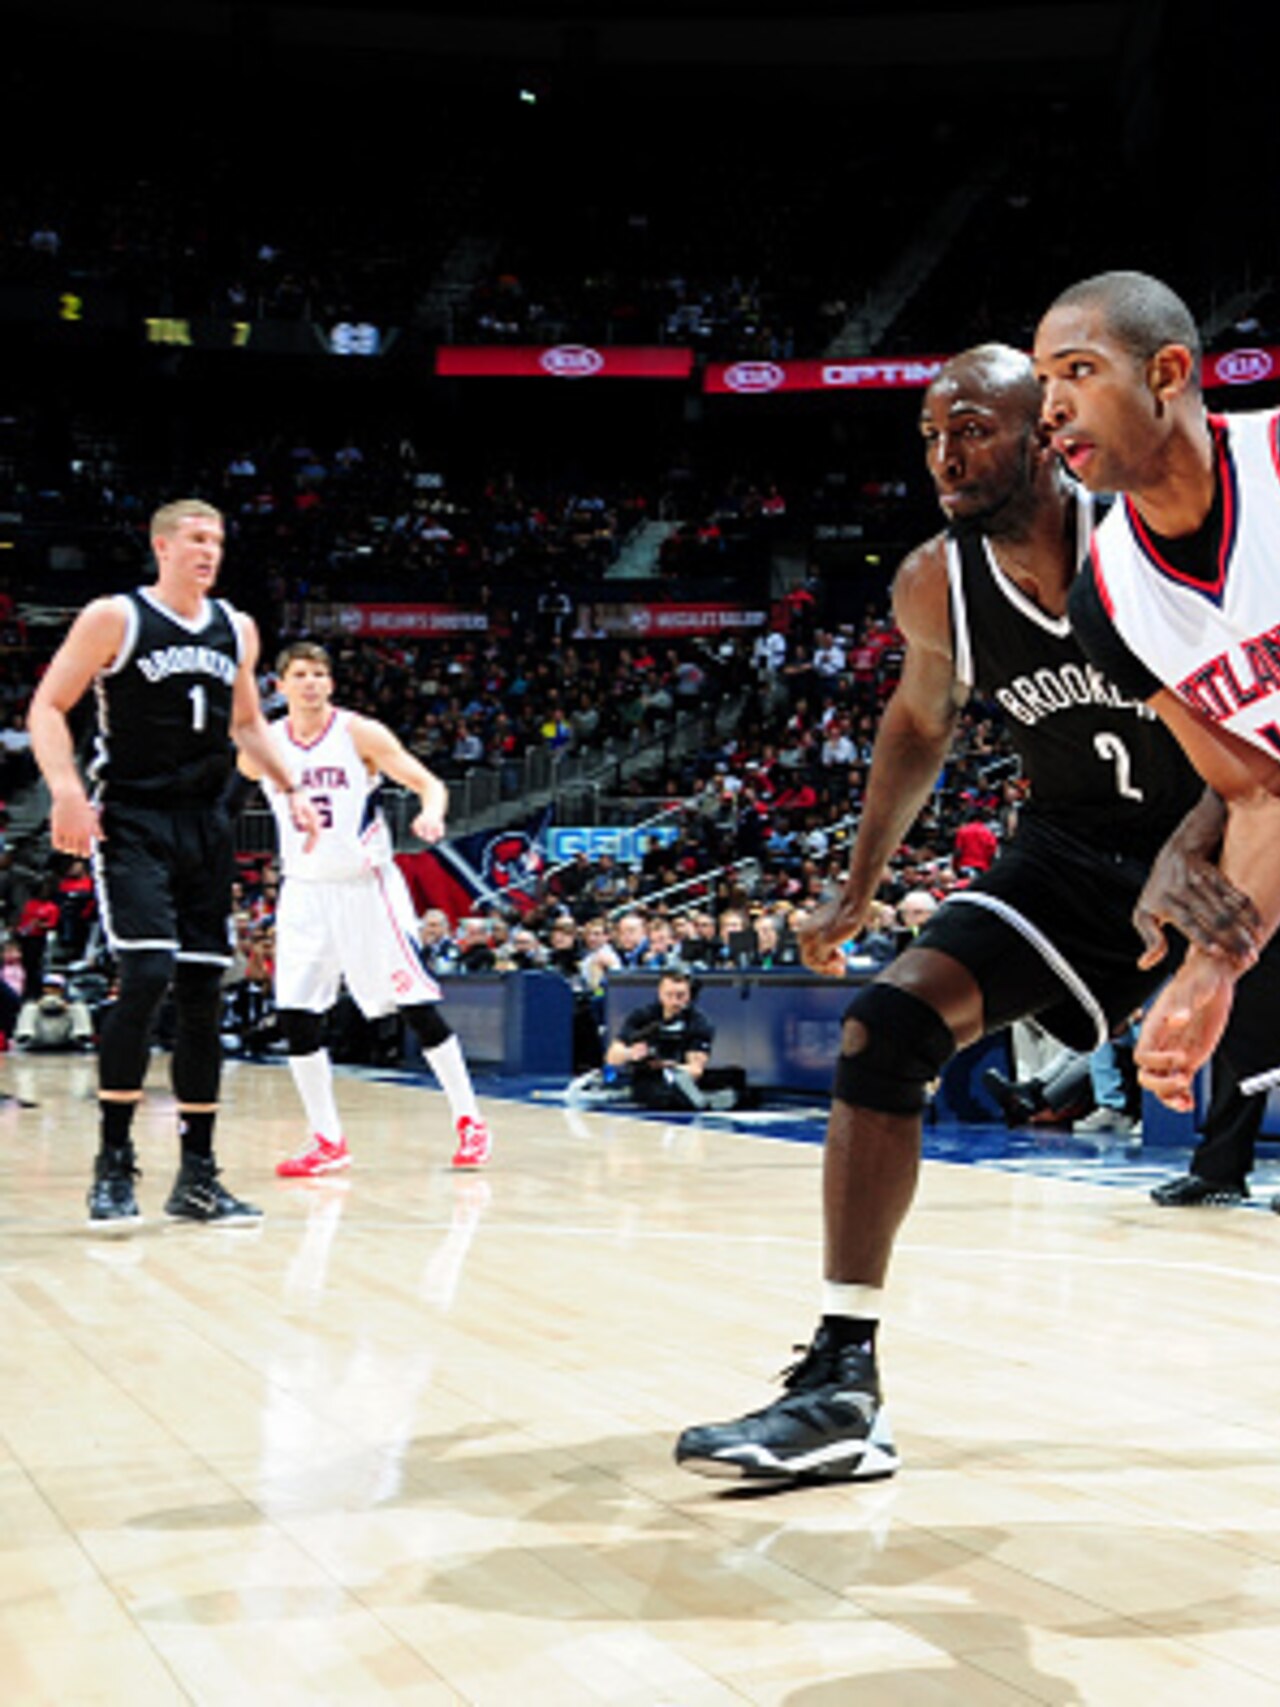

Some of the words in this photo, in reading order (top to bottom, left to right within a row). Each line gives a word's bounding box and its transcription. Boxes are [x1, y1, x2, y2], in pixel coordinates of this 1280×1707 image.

[823, 362, 941, 385] OPTIM
[188, 683, 207, 731] 1
[996, 662, 1156, 726] BROOKL
[1093, 732, 1143, 801] 2
